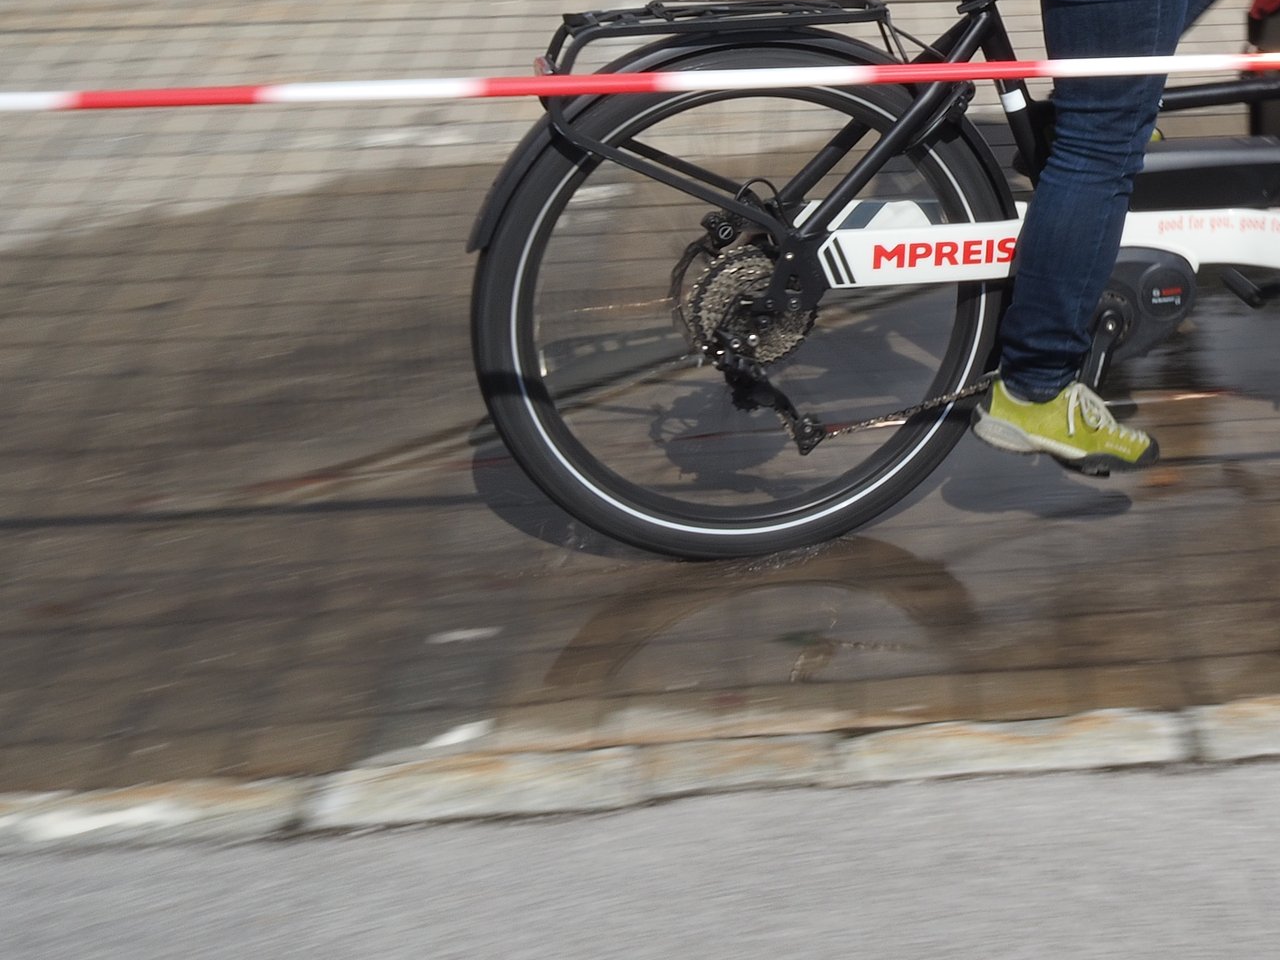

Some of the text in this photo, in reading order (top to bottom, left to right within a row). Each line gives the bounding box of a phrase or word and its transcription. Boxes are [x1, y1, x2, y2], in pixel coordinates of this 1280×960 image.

[1158, 215, 1183, 234] good
[1188, 215, 1204, 229] for
[1240, 216, 1266, 232] good
[873, 238, 1017, 269] MPREIS
